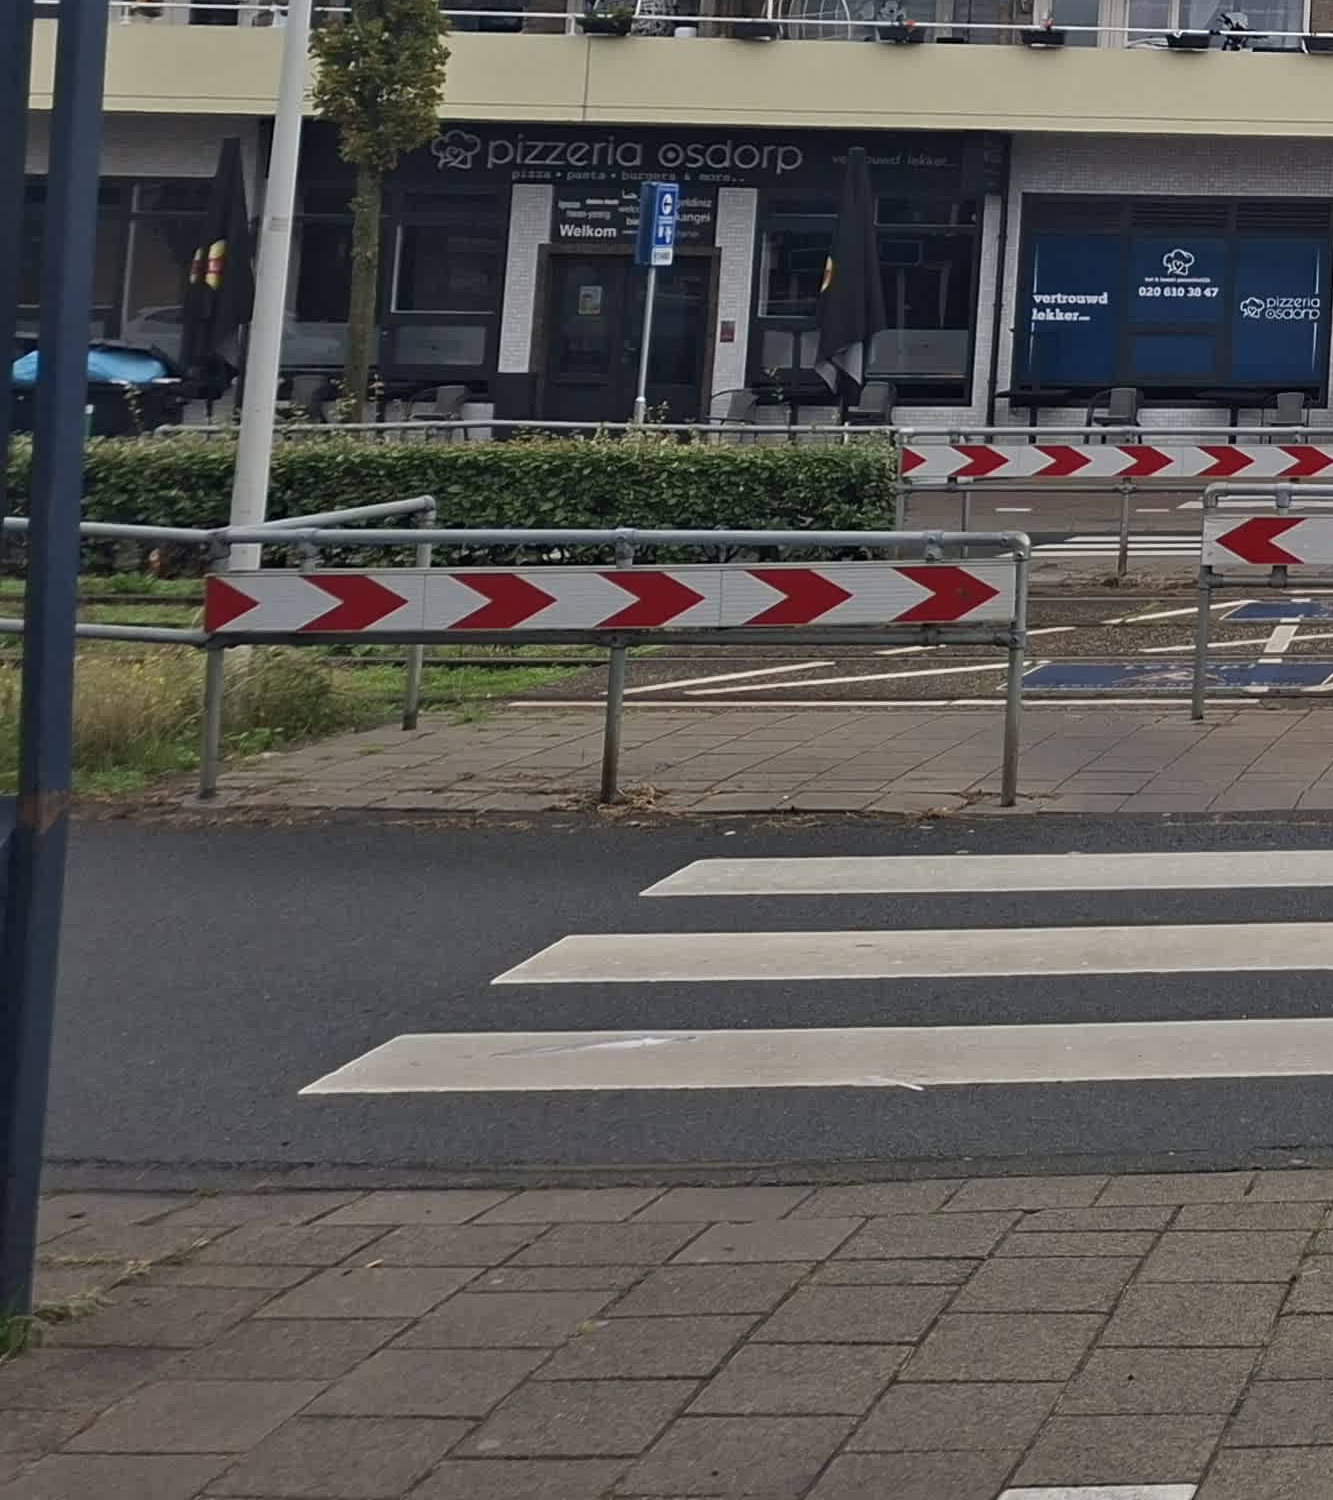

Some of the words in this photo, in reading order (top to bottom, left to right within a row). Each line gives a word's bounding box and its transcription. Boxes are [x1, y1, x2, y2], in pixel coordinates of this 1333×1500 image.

[487, 134, 643, 169] pizzeria
[658, 140, 803, 175] osdorp
[511, 170, 551, 181] pizza
[559, 224, 617, 238] Welkom
[1138, 286, 1161, 297] 020
[1163, 286, 1185, 297] 610
[1186, 286, 1202, 297] 38
[1203, 287, 1219, 297] 47
[1033, 292, 1109, 305] vertrouwd
[1266, 296, 1321, 309] pizzeria
[1265, 307, 1321, 321] osdorp
